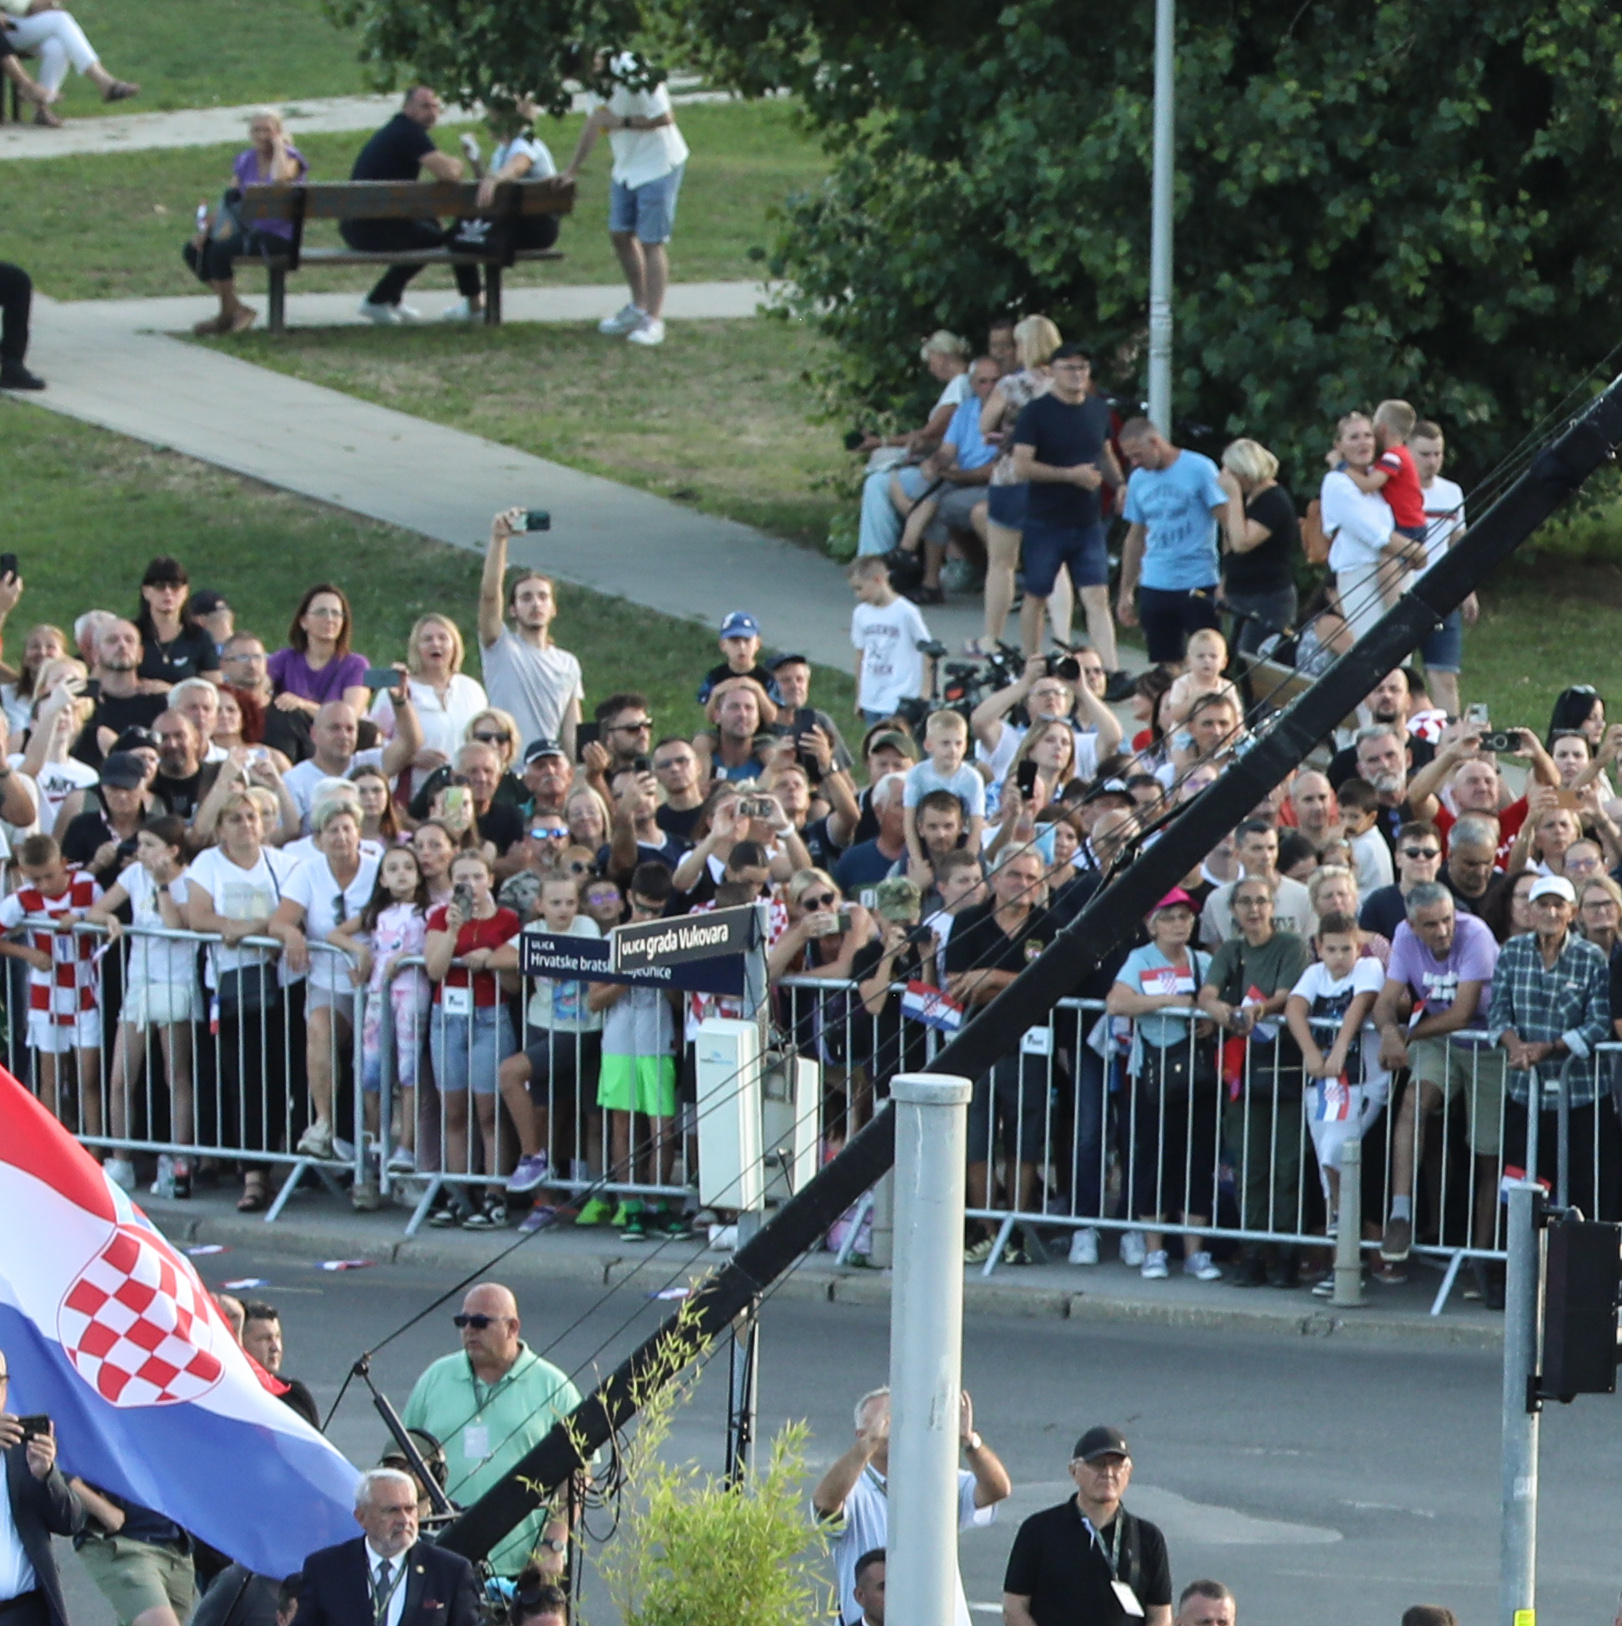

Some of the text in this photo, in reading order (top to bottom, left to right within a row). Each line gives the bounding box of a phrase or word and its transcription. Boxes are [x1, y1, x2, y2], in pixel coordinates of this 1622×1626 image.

[531, 940, 555, 951] ULICA
[621, 923, 729, 961] ULICA grada Vukovara
[531, 952, 579, 970] Hrvatske
